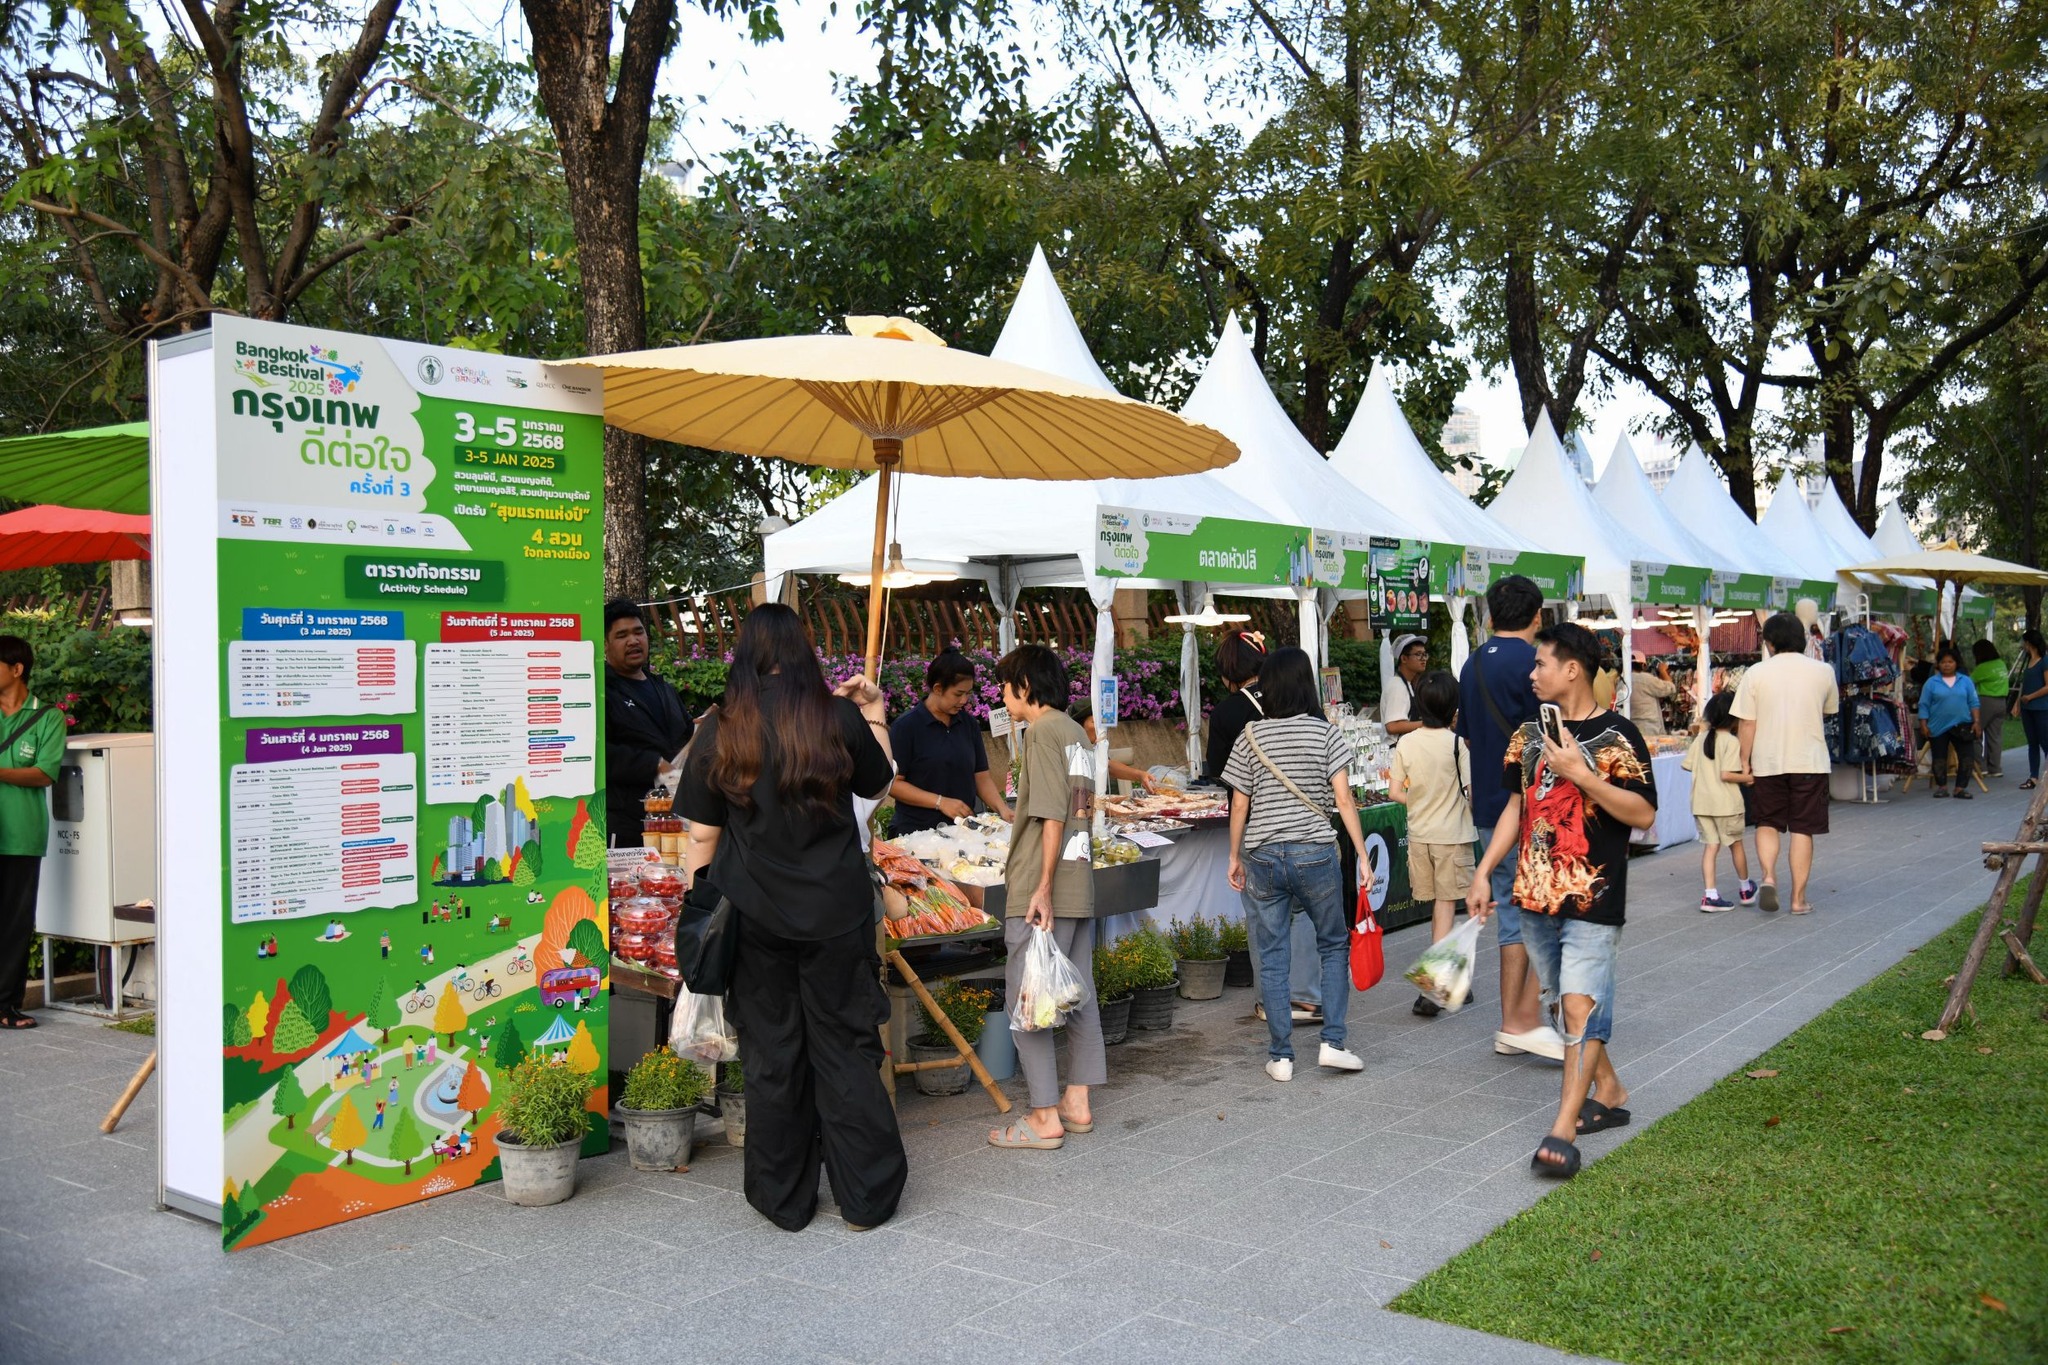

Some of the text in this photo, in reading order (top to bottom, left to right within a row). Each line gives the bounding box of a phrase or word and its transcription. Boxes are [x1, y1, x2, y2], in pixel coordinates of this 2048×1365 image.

[236, 341, 309, 363] Bangkok
[258, 360, 324, 381] Bestival
[288, 379, 325, 396] 2025
[232, 389, 380, 433] กรุงเทพ
[454, 412, 518, 447] 3-5
[522, 420, 564, 432] มกราคม
[300, 427, 411, 472] ดีต่อใจ
[522, 433, 564, 450] 2568
[465, 450, 555, 469] 3-5 JAN 2025
[350, 473, 411, 497] ครั้งที่ 3
[454, 503, 487, 517] เปิดรับ
[240, 515, 255, 524] SX
[532, 528, 582, 546] 4 สวน
[1100, 530, 1132, 546] กรุงเทพ
[524, 545, 591, 559] ใจกลางเมือง
[1114, 543, 1139, 559] ดีต่อใจ
[1199, 548, 1257, 570] ตลาดหัวปลี
[365, 563, 481, 581] ตารางกิจกรรม
[379, 583, 468, 595] (Activity Schedule)
[307, 615, 315, 625] 3
[317, 616, 358, 626] มกราคม
[360, 615, 389, 626] 2568
[501, 617, 508, 627] 5
[510, 618, 547, 628] มกราคม
[549, 618, 575, 628] 2568
[300, 628, 352, 636] (3 Jan 2025)
[490, 629, 498, 637] (5
[514, 629, 535, 637] 2025)
[261, 729, 390, 745] วันเสาร์ที่ 4 มกราคม 2568
[301, 744, 353, 754] (4 Jan 2025)
[57, 830, 69, 839] NCC
